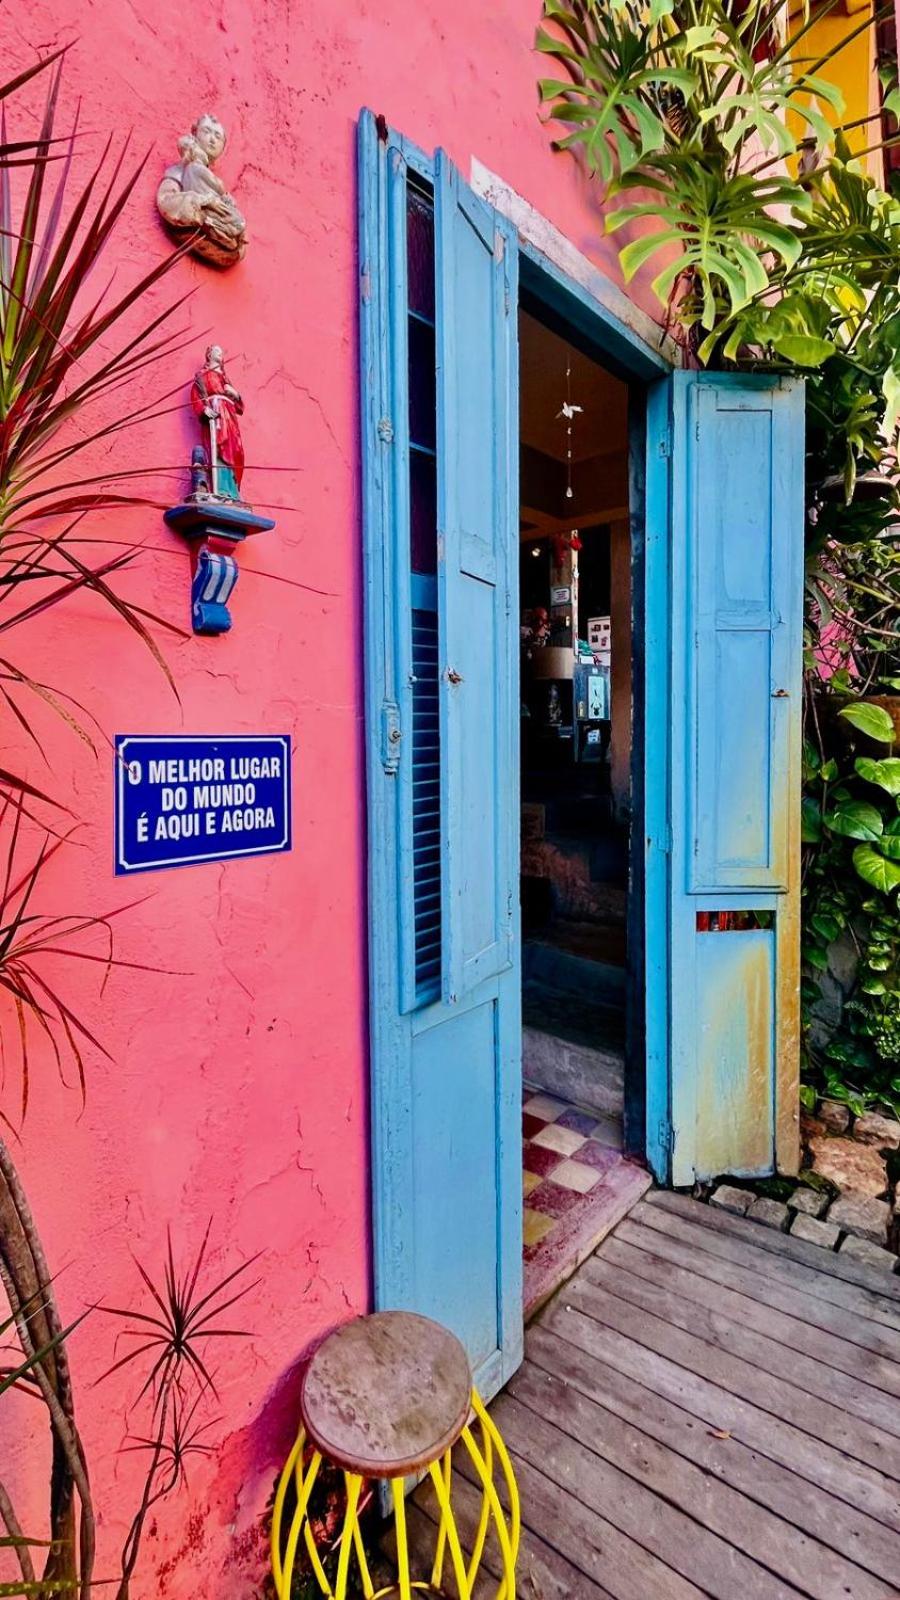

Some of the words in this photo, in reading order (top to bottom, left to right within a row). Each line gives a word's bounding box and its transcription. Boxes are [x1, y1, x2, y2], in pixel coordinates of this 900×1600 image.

[128, 761, 141, 785] O
[149, 759, 225, 784] MELHOR
[231, 757, 280, 780] LUGAR
[162, 787, 187, 812] DO
[194, 783, 255, 809] MUNDO
[137, 812, 148, 842] É
[154, 813, 199, 842] AQUI
[206, 812, 216, 835] E
[221, 807, 275, 833] AGORA
